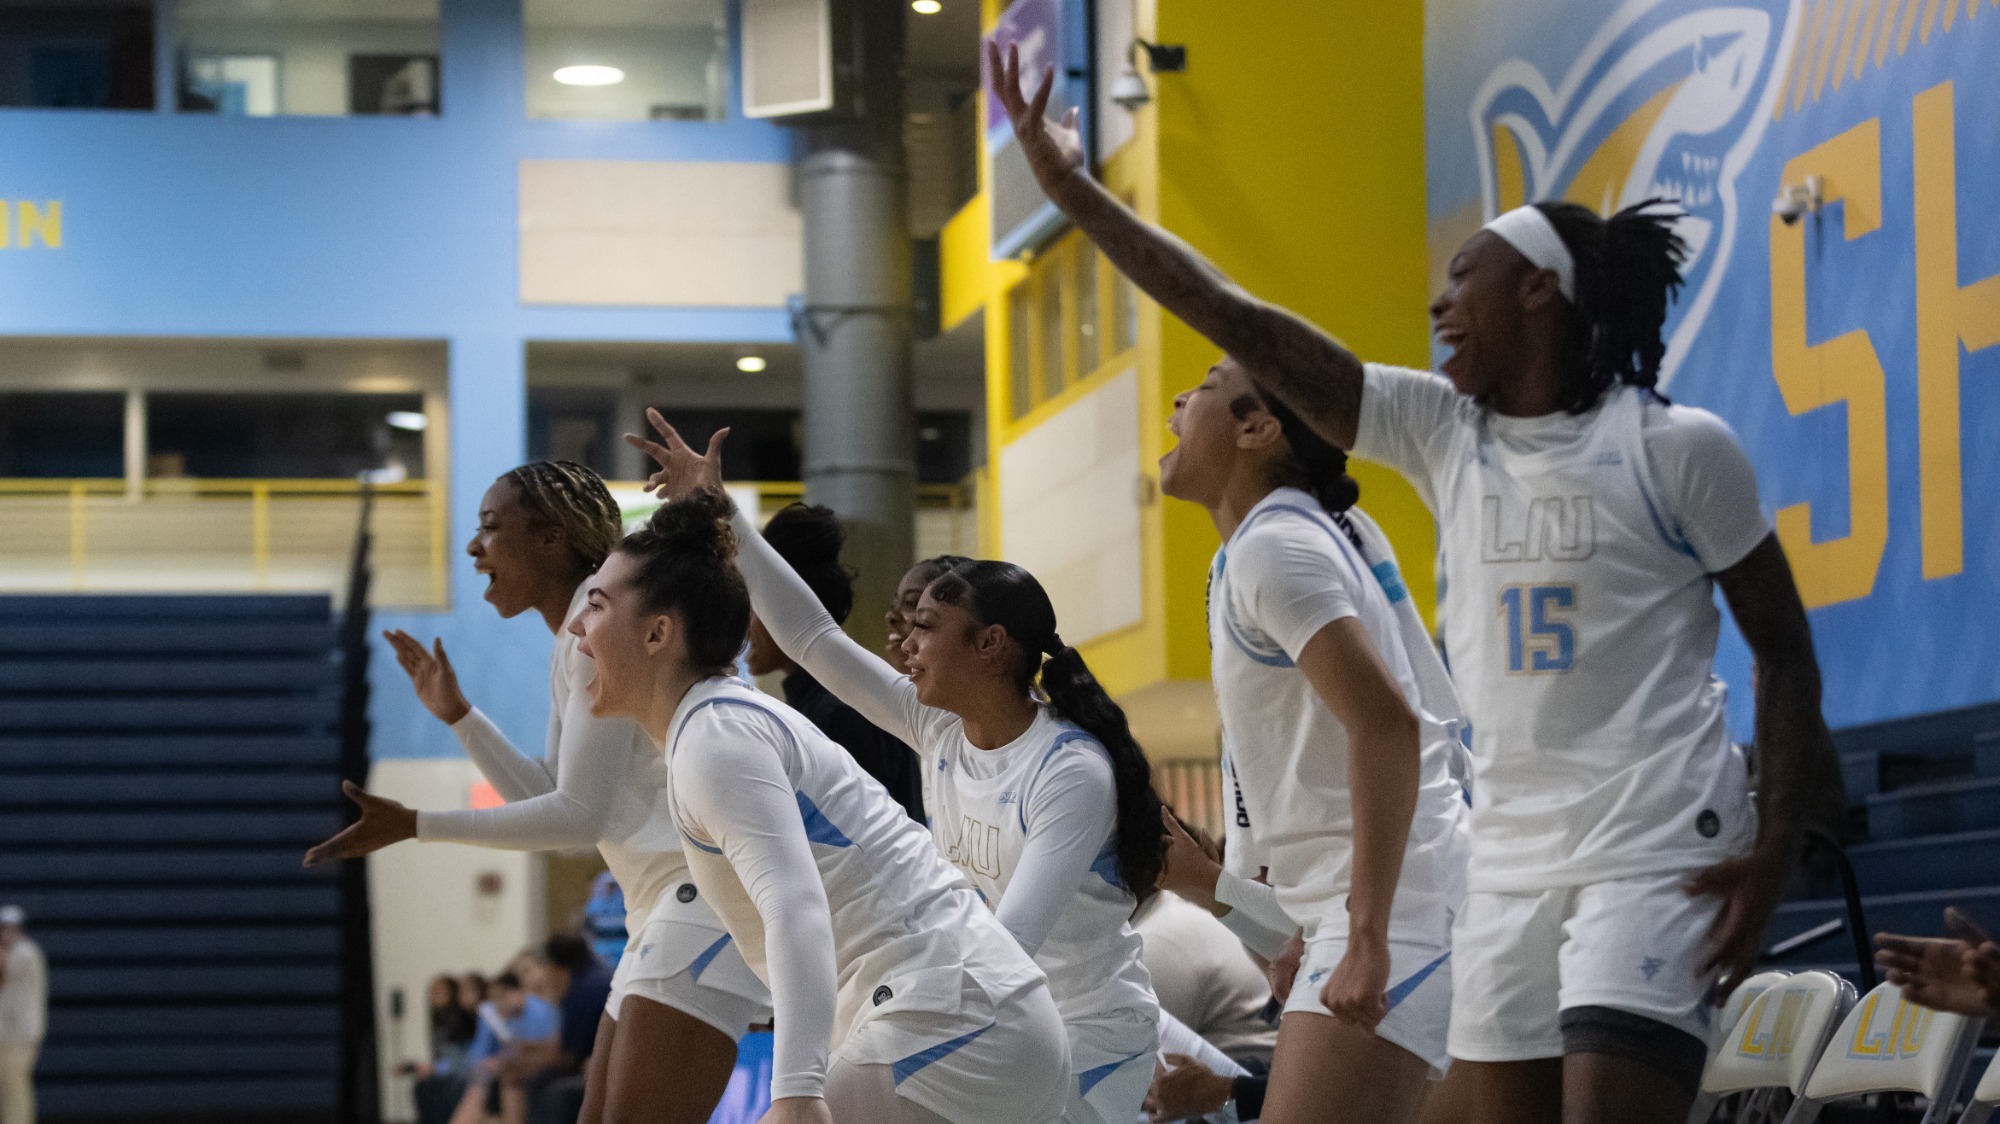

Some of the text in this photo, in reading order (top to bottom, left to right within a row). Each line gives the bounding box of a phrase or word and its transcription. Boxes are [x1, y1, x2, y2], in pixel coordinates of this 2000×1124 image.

[0, 200, 62, 249] N
[1480, 494, 1596, 564] LIU
[1497, 581, 1578, 677] 15
[1845, 985, 1935, 1061] LIU
